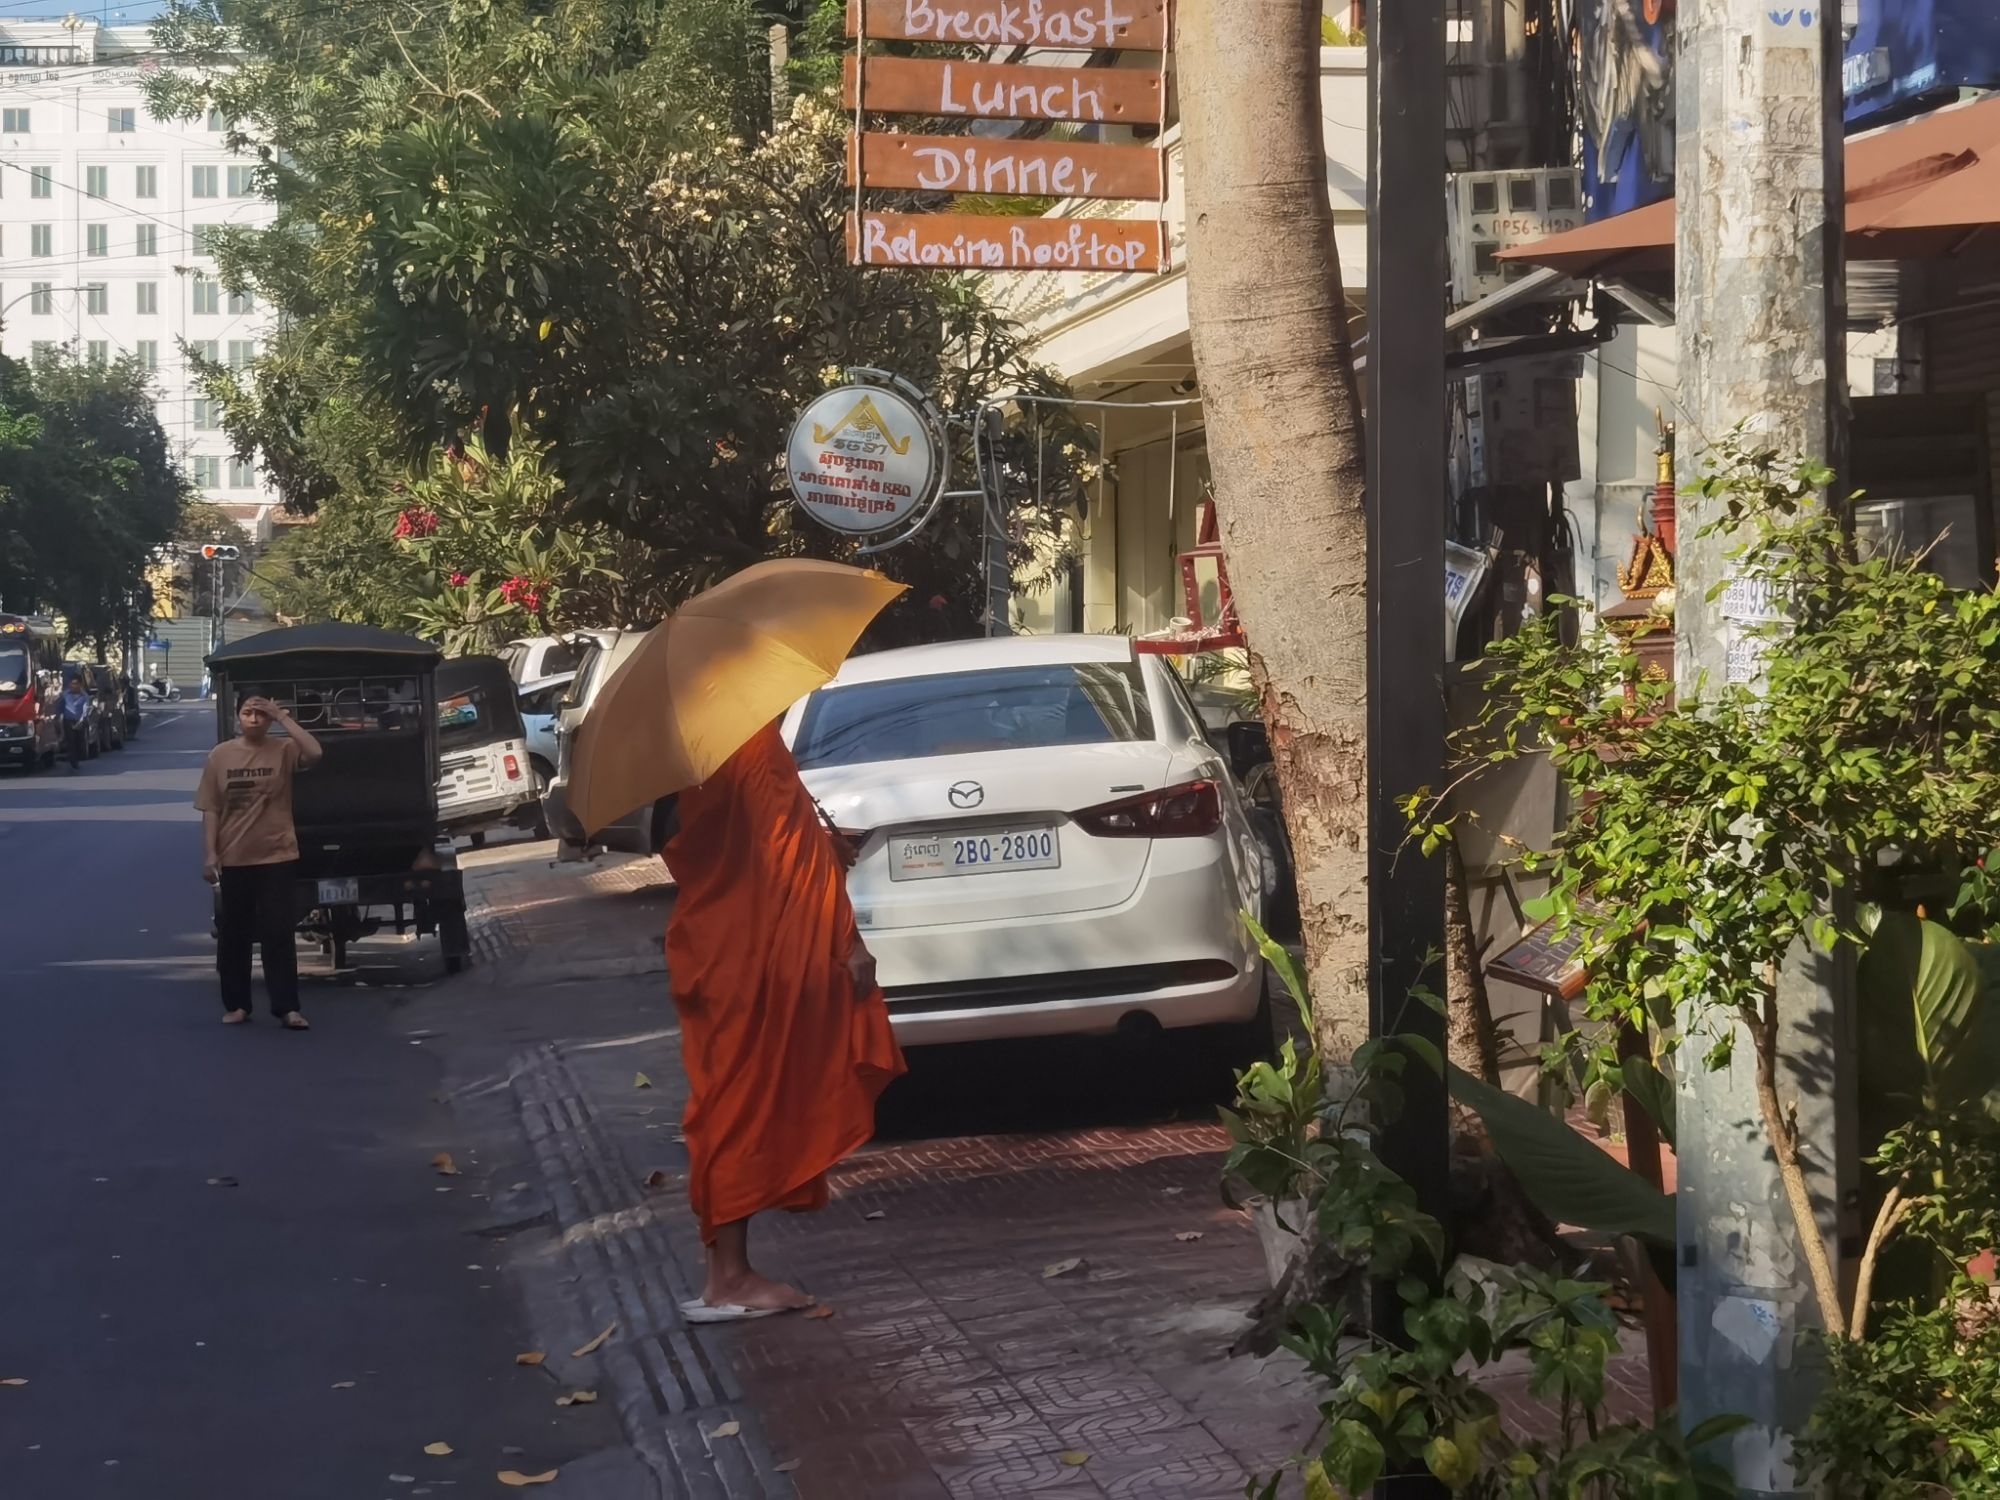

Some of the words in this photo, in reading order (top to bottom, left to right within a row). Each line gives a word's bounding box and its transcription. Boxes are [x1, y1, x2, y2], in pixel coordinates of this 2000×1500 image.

[904, 0, 1133, 47] Breakfast
[940, 63, 1104, 121] Lunch
[913, 148, 1097, 194] Dinner
[1009, 223, 1145, 269] Rooftop
